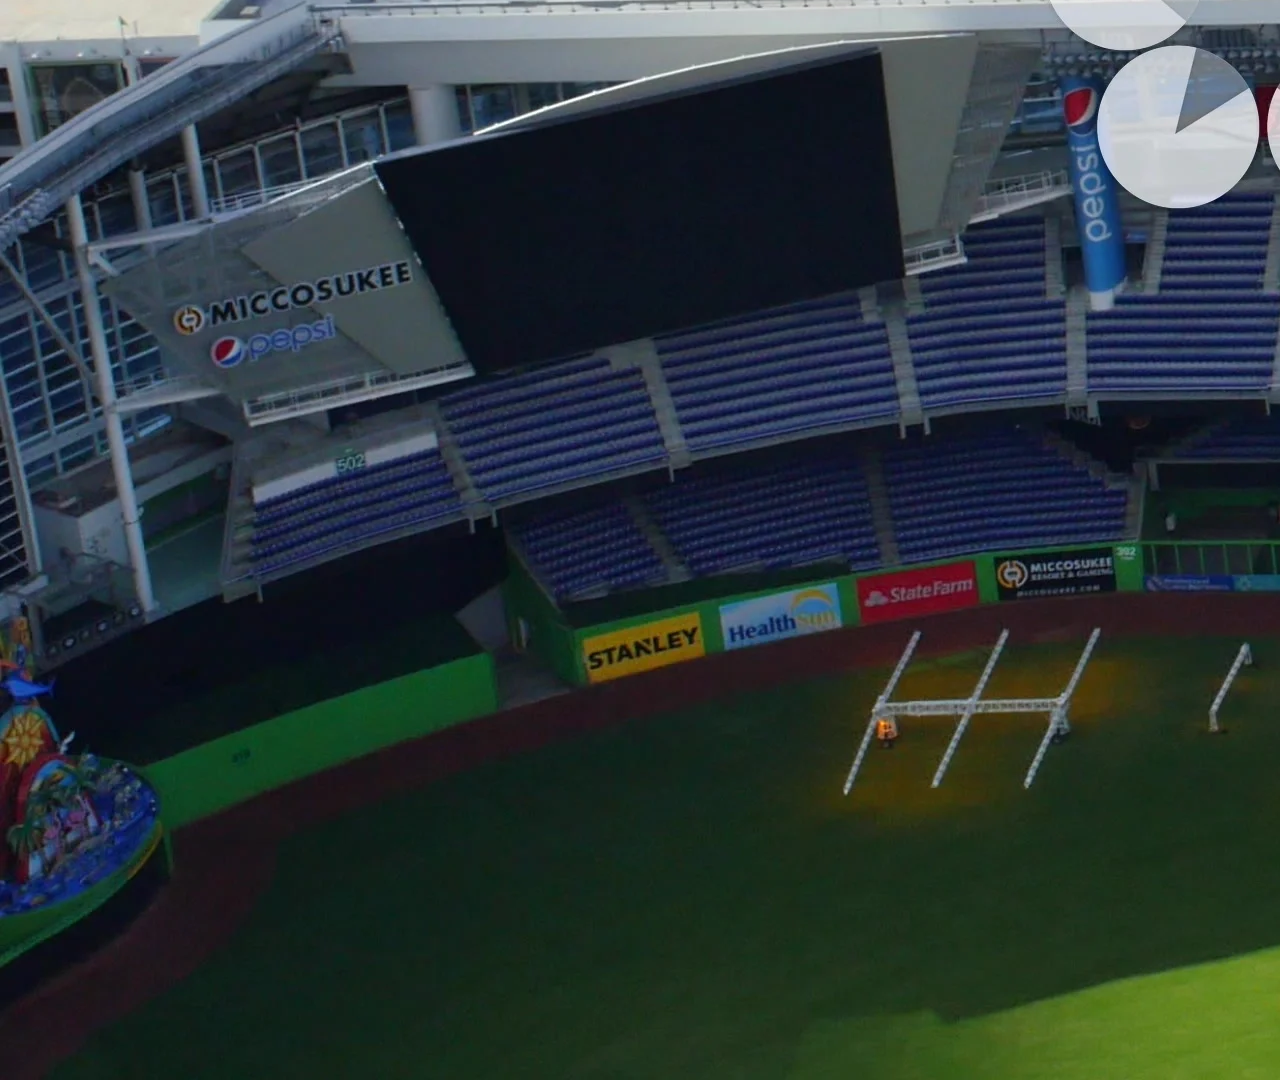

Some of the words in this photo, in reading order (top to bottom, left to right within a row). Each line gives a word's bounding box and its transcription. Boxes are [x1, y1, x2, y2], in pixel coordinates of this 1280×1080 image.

[1071, 144, 1113, 243] pepsi
[209, 260, 413, 326] MICCOSUKEE
[249, 313, 336, 360] pepsi
[337, 453, 365, 473] 502
[1030, 556, 1113, 573] MICCOSUKEE
[588, 626, 698, 671] STANLEY
